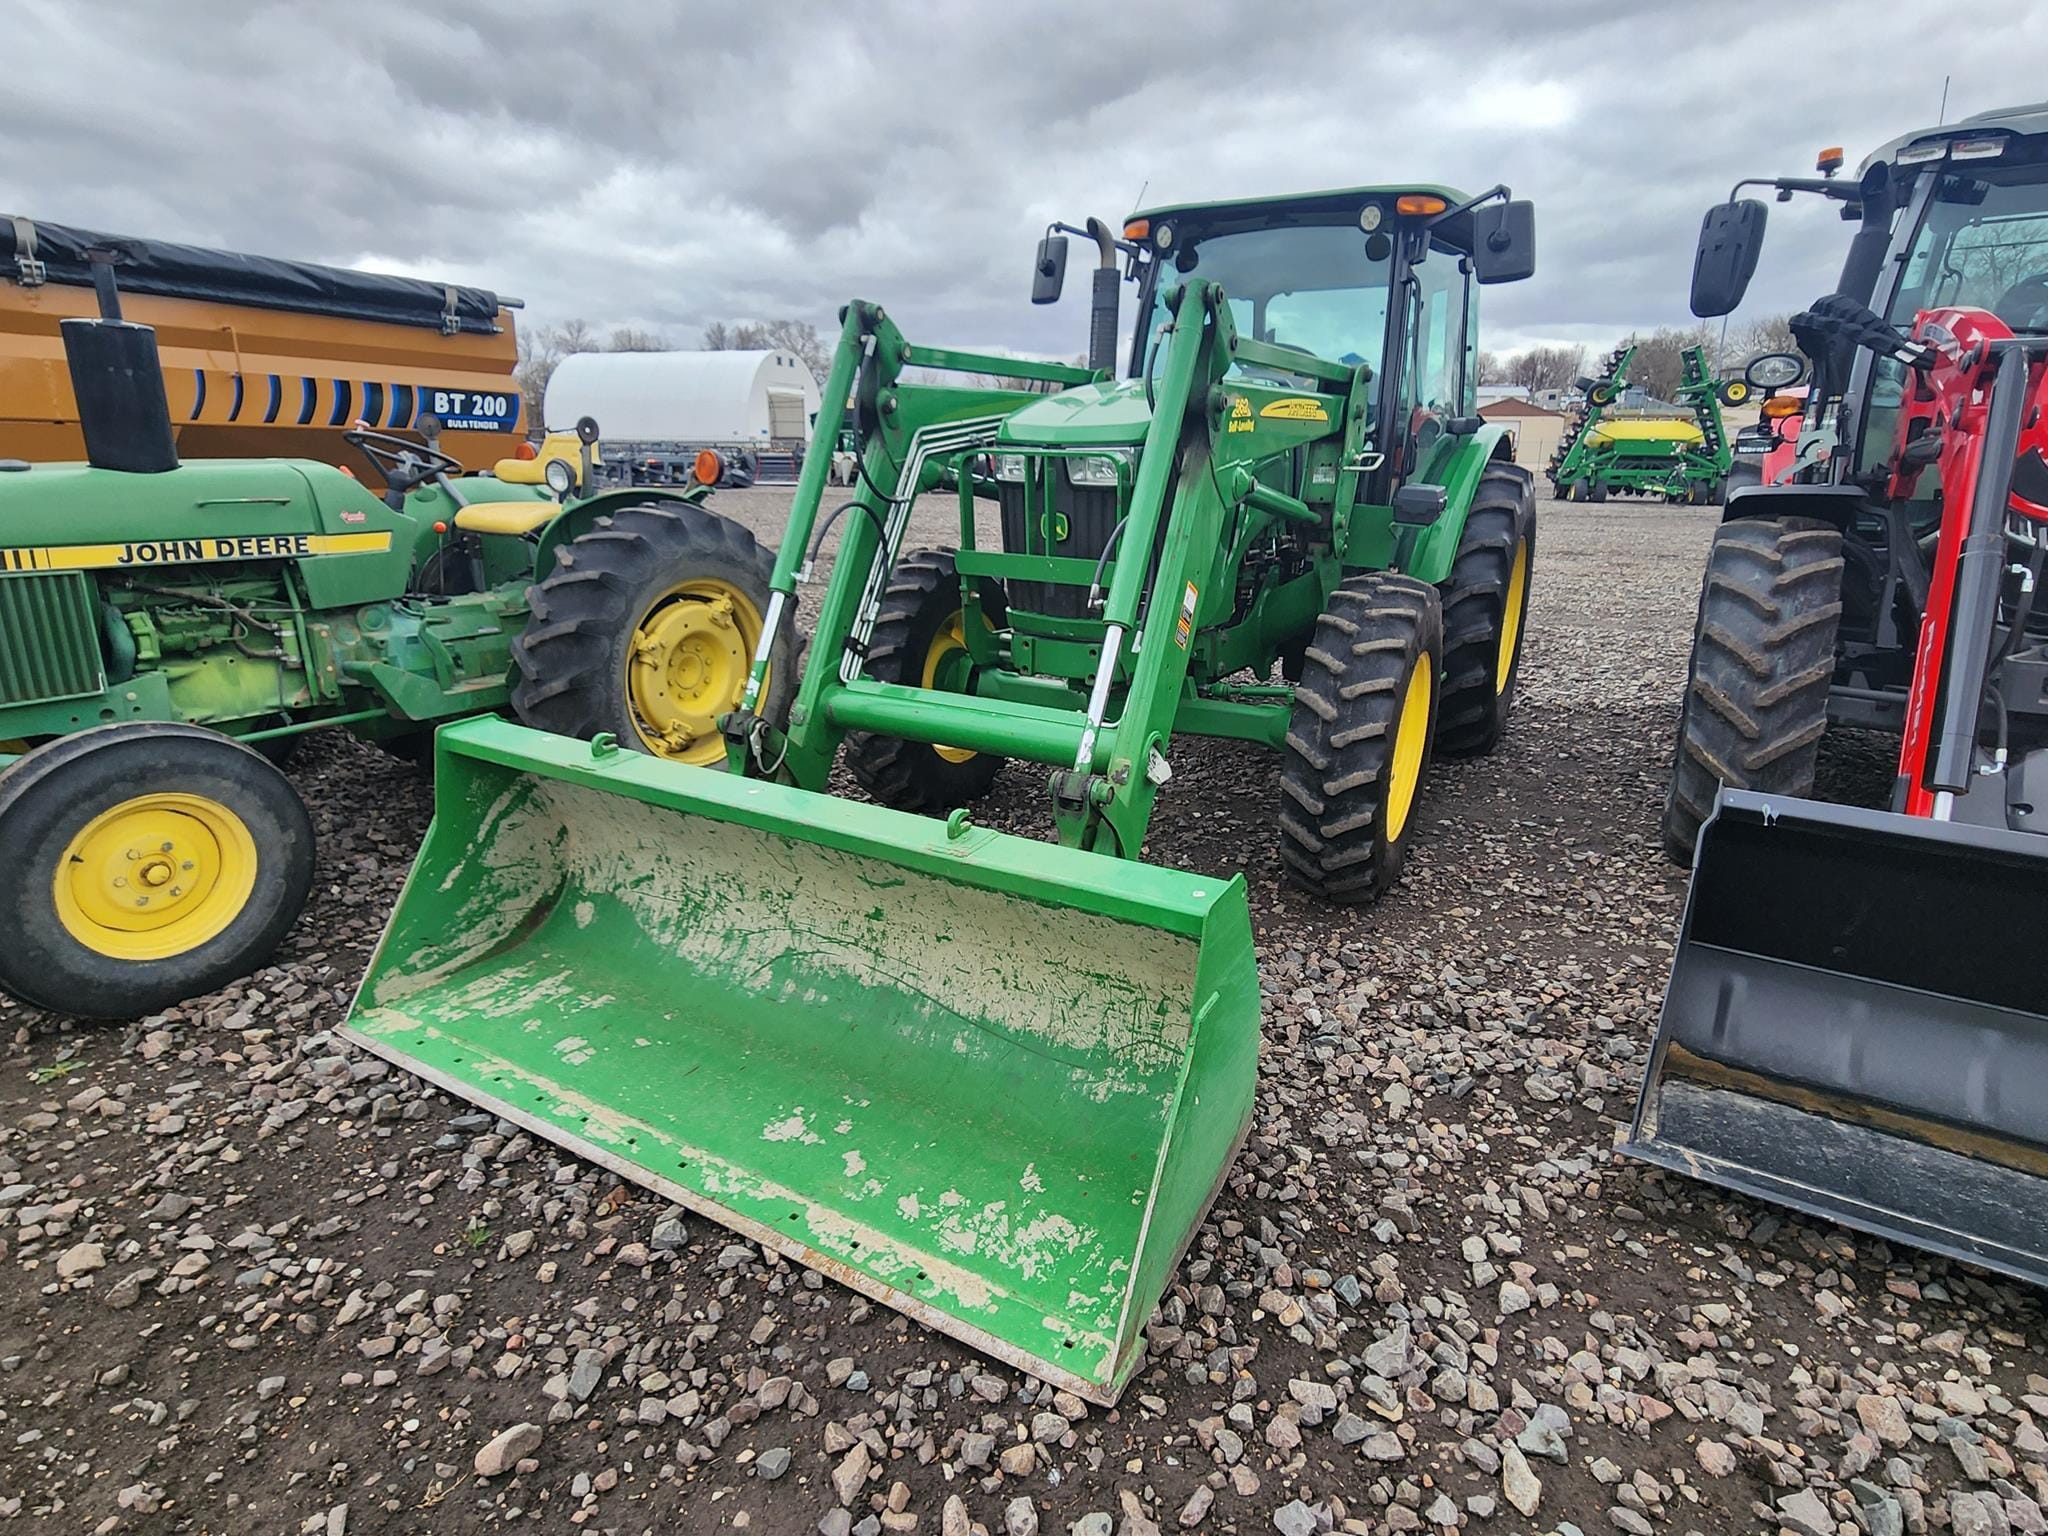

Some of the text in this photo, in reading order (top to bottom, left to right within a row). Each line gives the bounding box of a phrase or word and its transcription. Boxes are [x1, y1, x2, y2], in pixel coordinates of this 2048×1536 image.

[434, 392, 507, 417] BT 200
[469, 420, 499, 430] TENDER
[118, 535, 309, 564] JOHN DEERE
